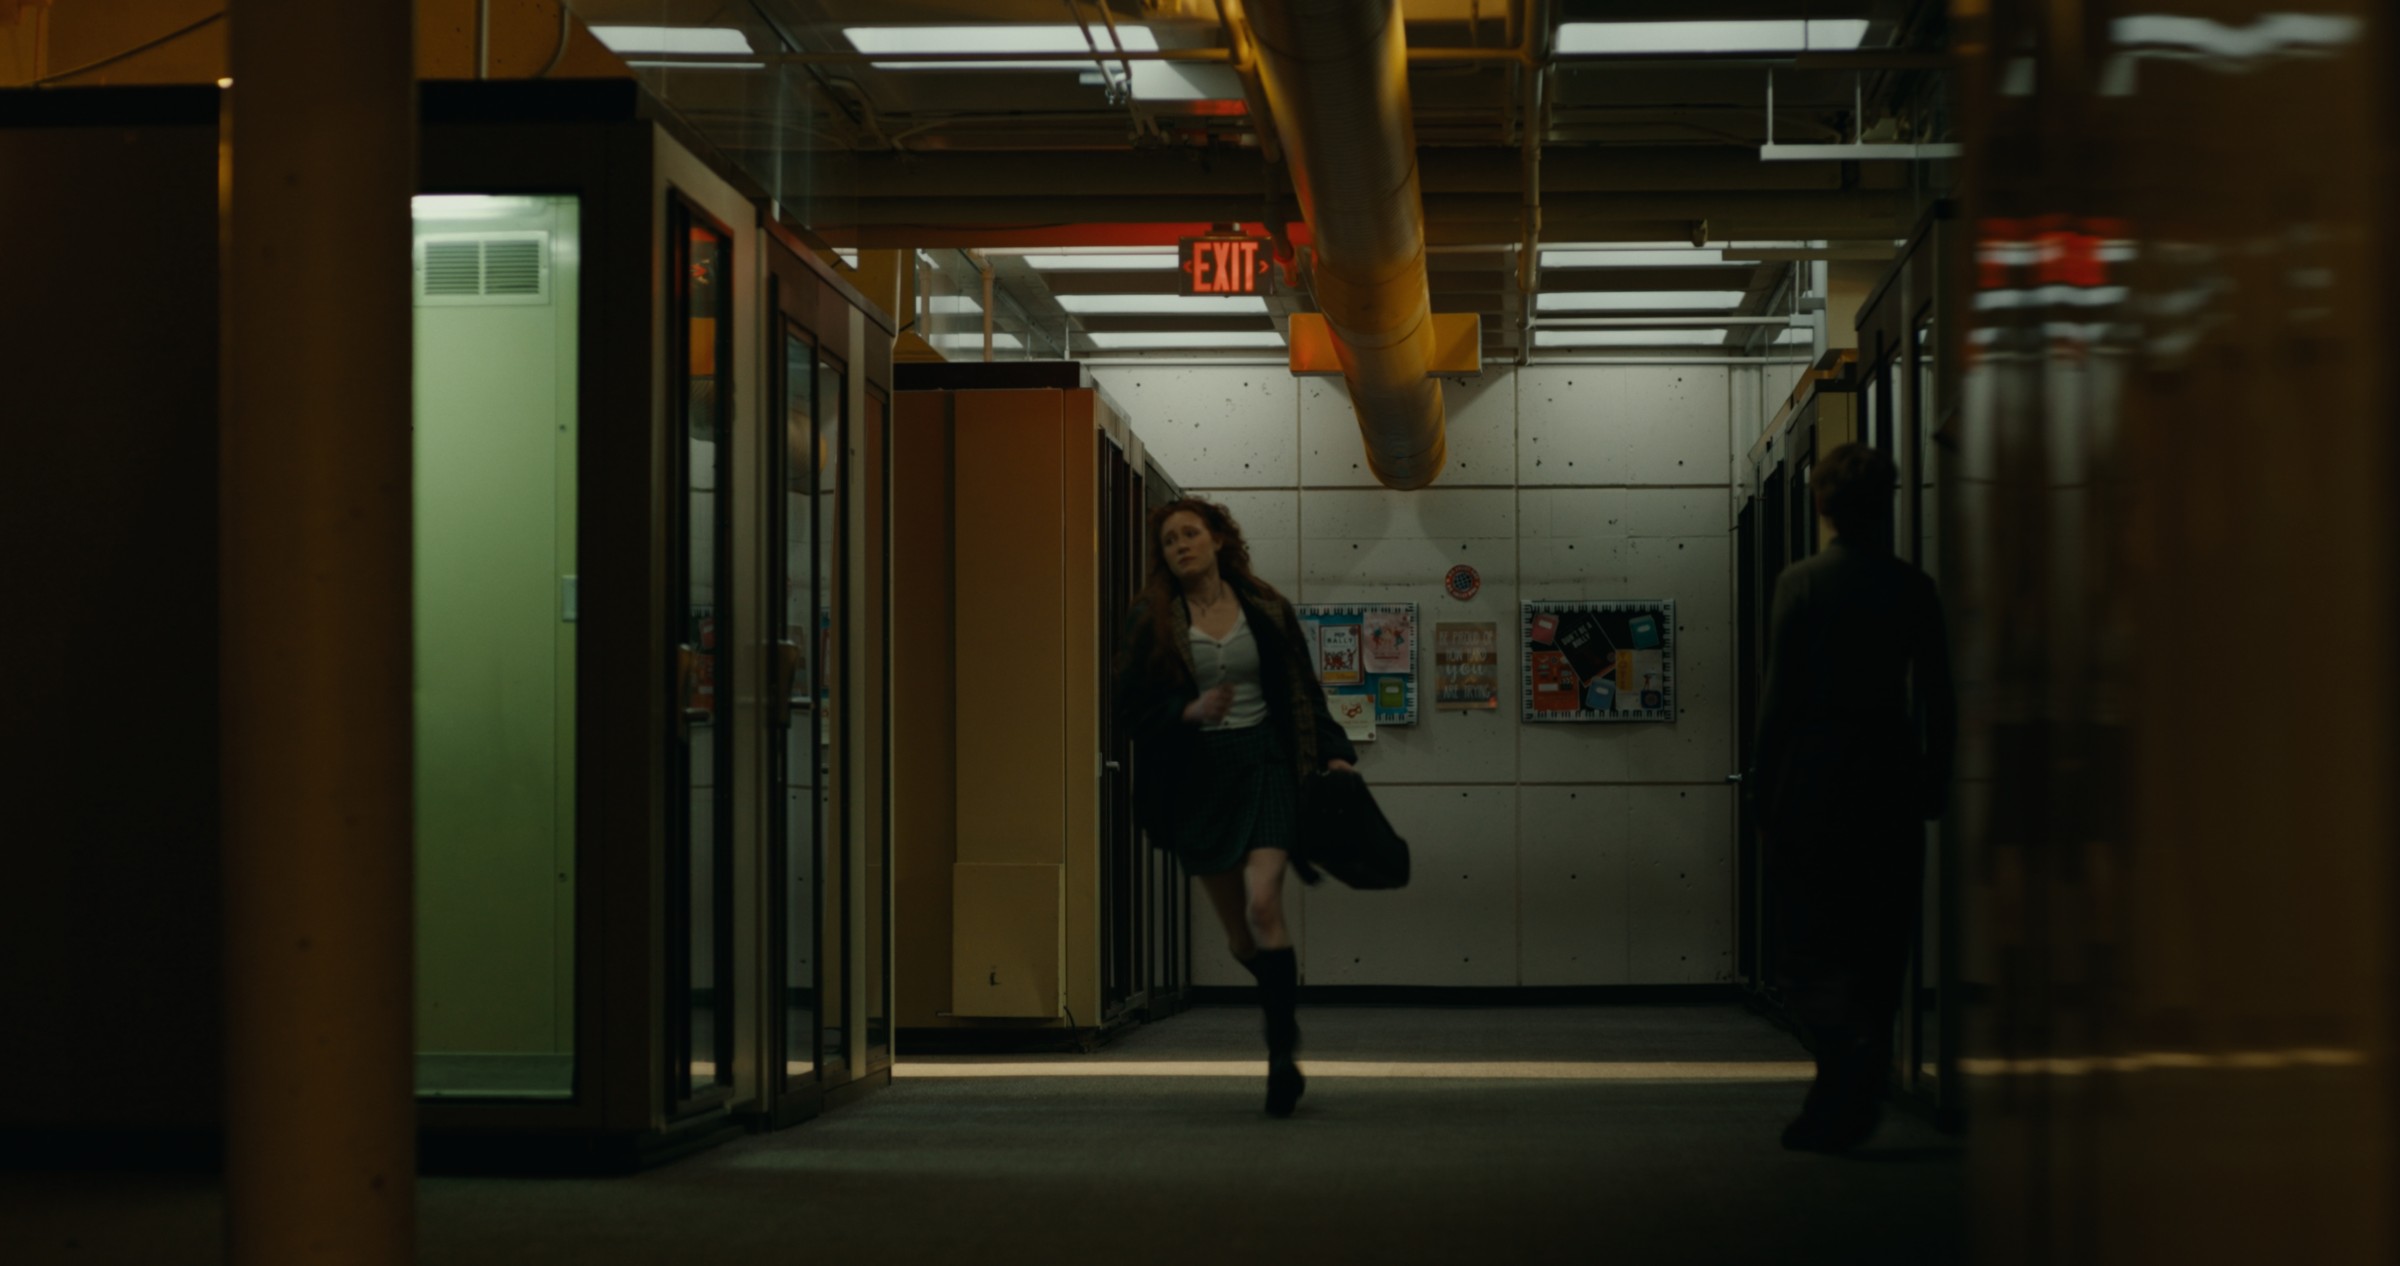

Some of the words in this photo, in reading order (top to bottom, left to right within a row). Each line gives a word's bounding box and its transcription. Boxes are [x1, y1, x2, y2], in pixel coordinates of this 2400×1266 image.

[1193, 241, 1258, 292] EXIT
[1453, 630, 1480, 646] PROUD
[1446, 663, 1484, 684] you
